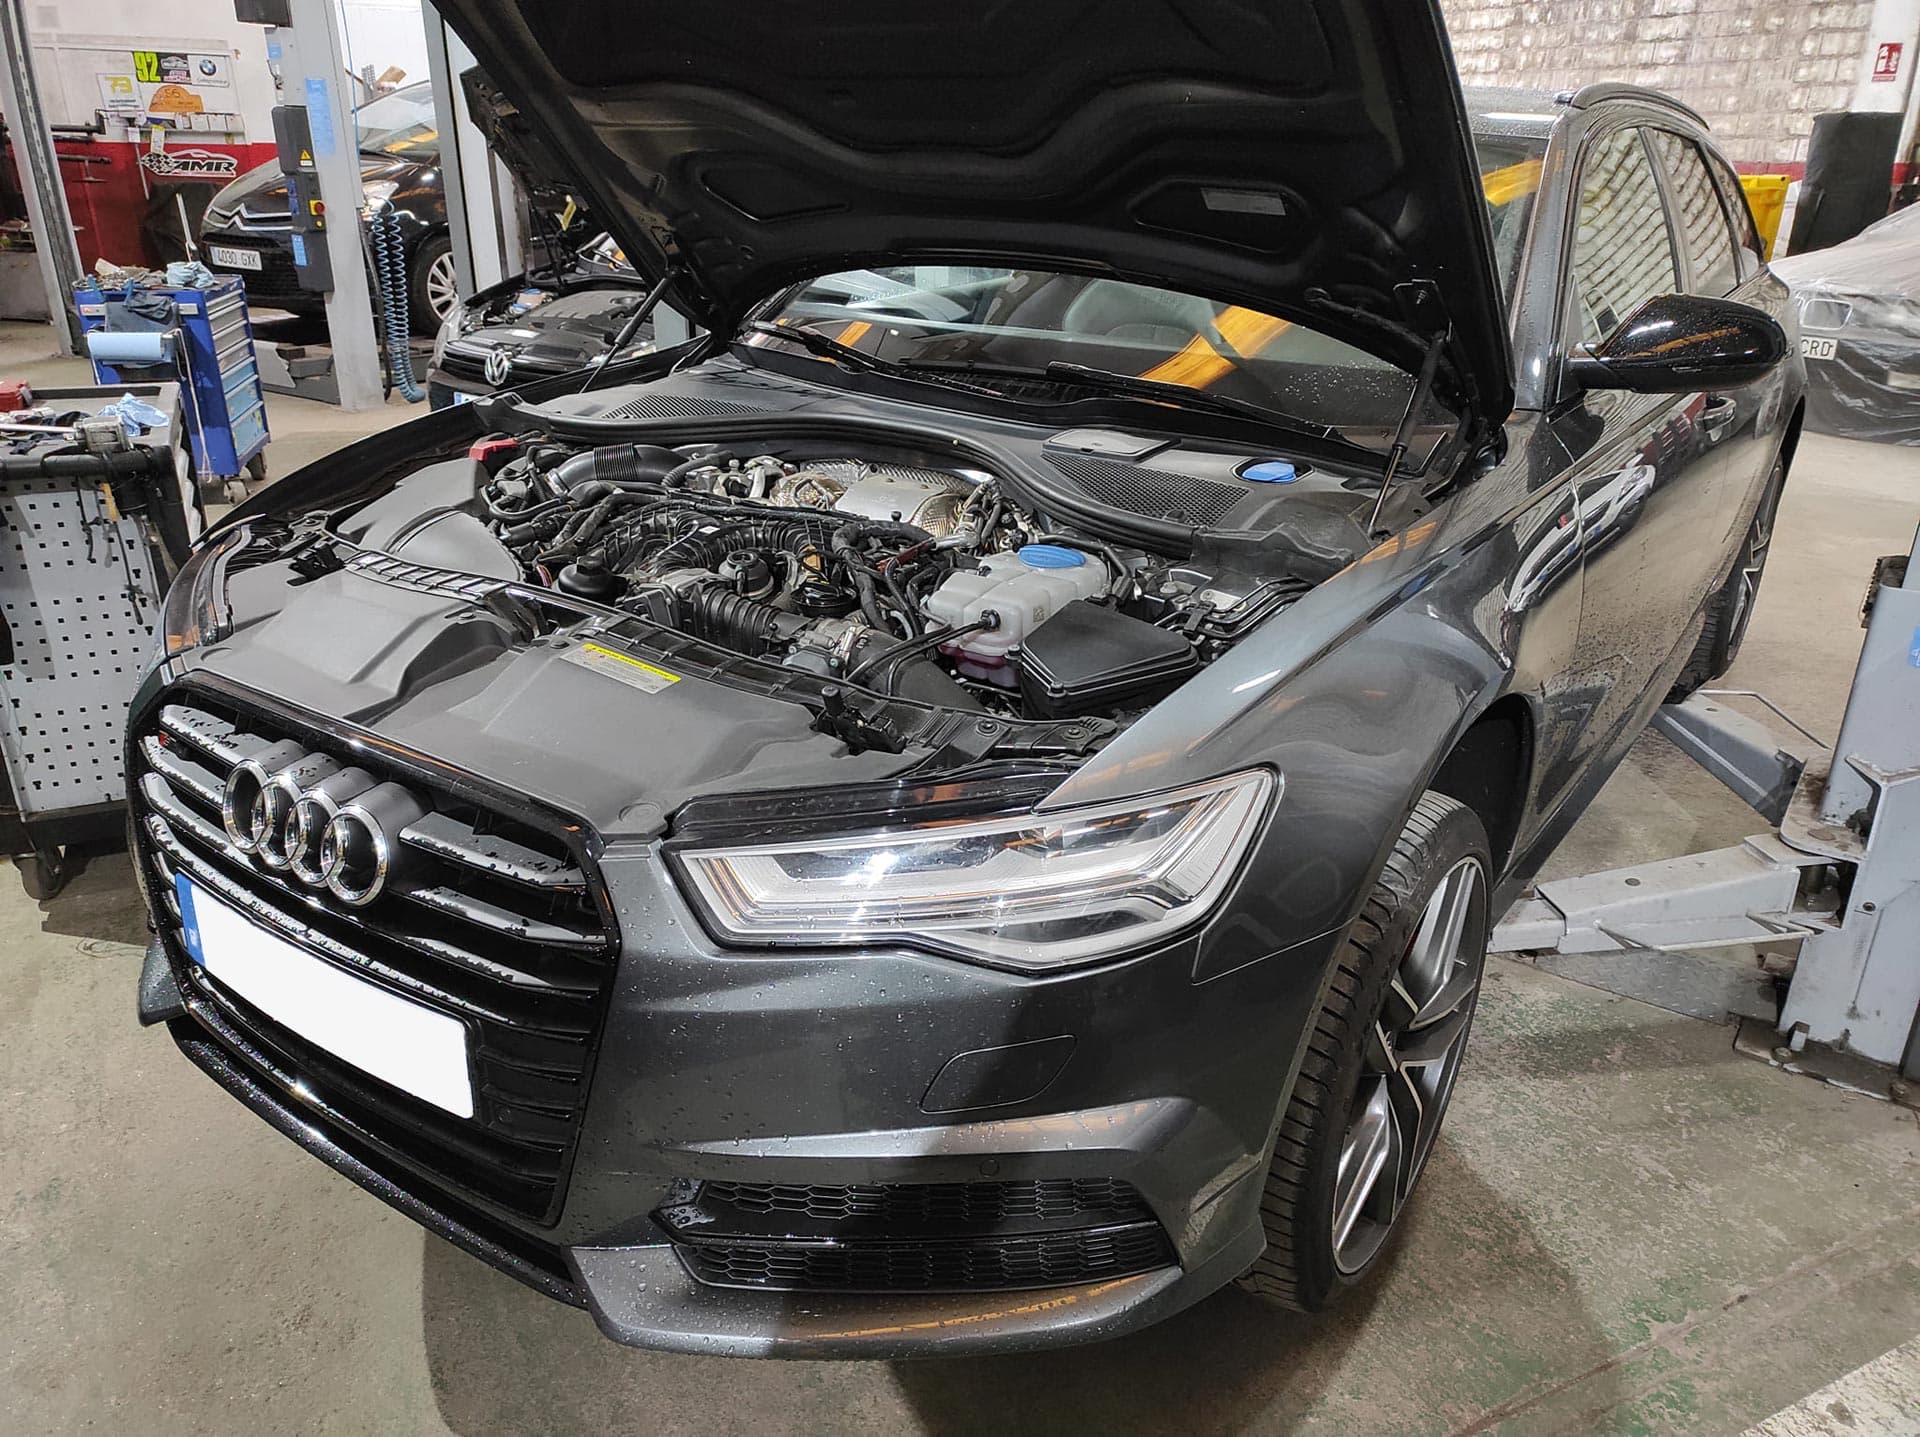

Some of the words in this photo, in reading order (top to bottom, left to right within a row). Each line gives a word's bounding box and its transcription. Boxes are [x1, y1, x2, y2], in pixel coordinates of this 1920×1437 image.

[133, 51, 161, 82] 92
[174, 161, 235, 172] AMR
[1800, 339, 1832, 357] CRD
